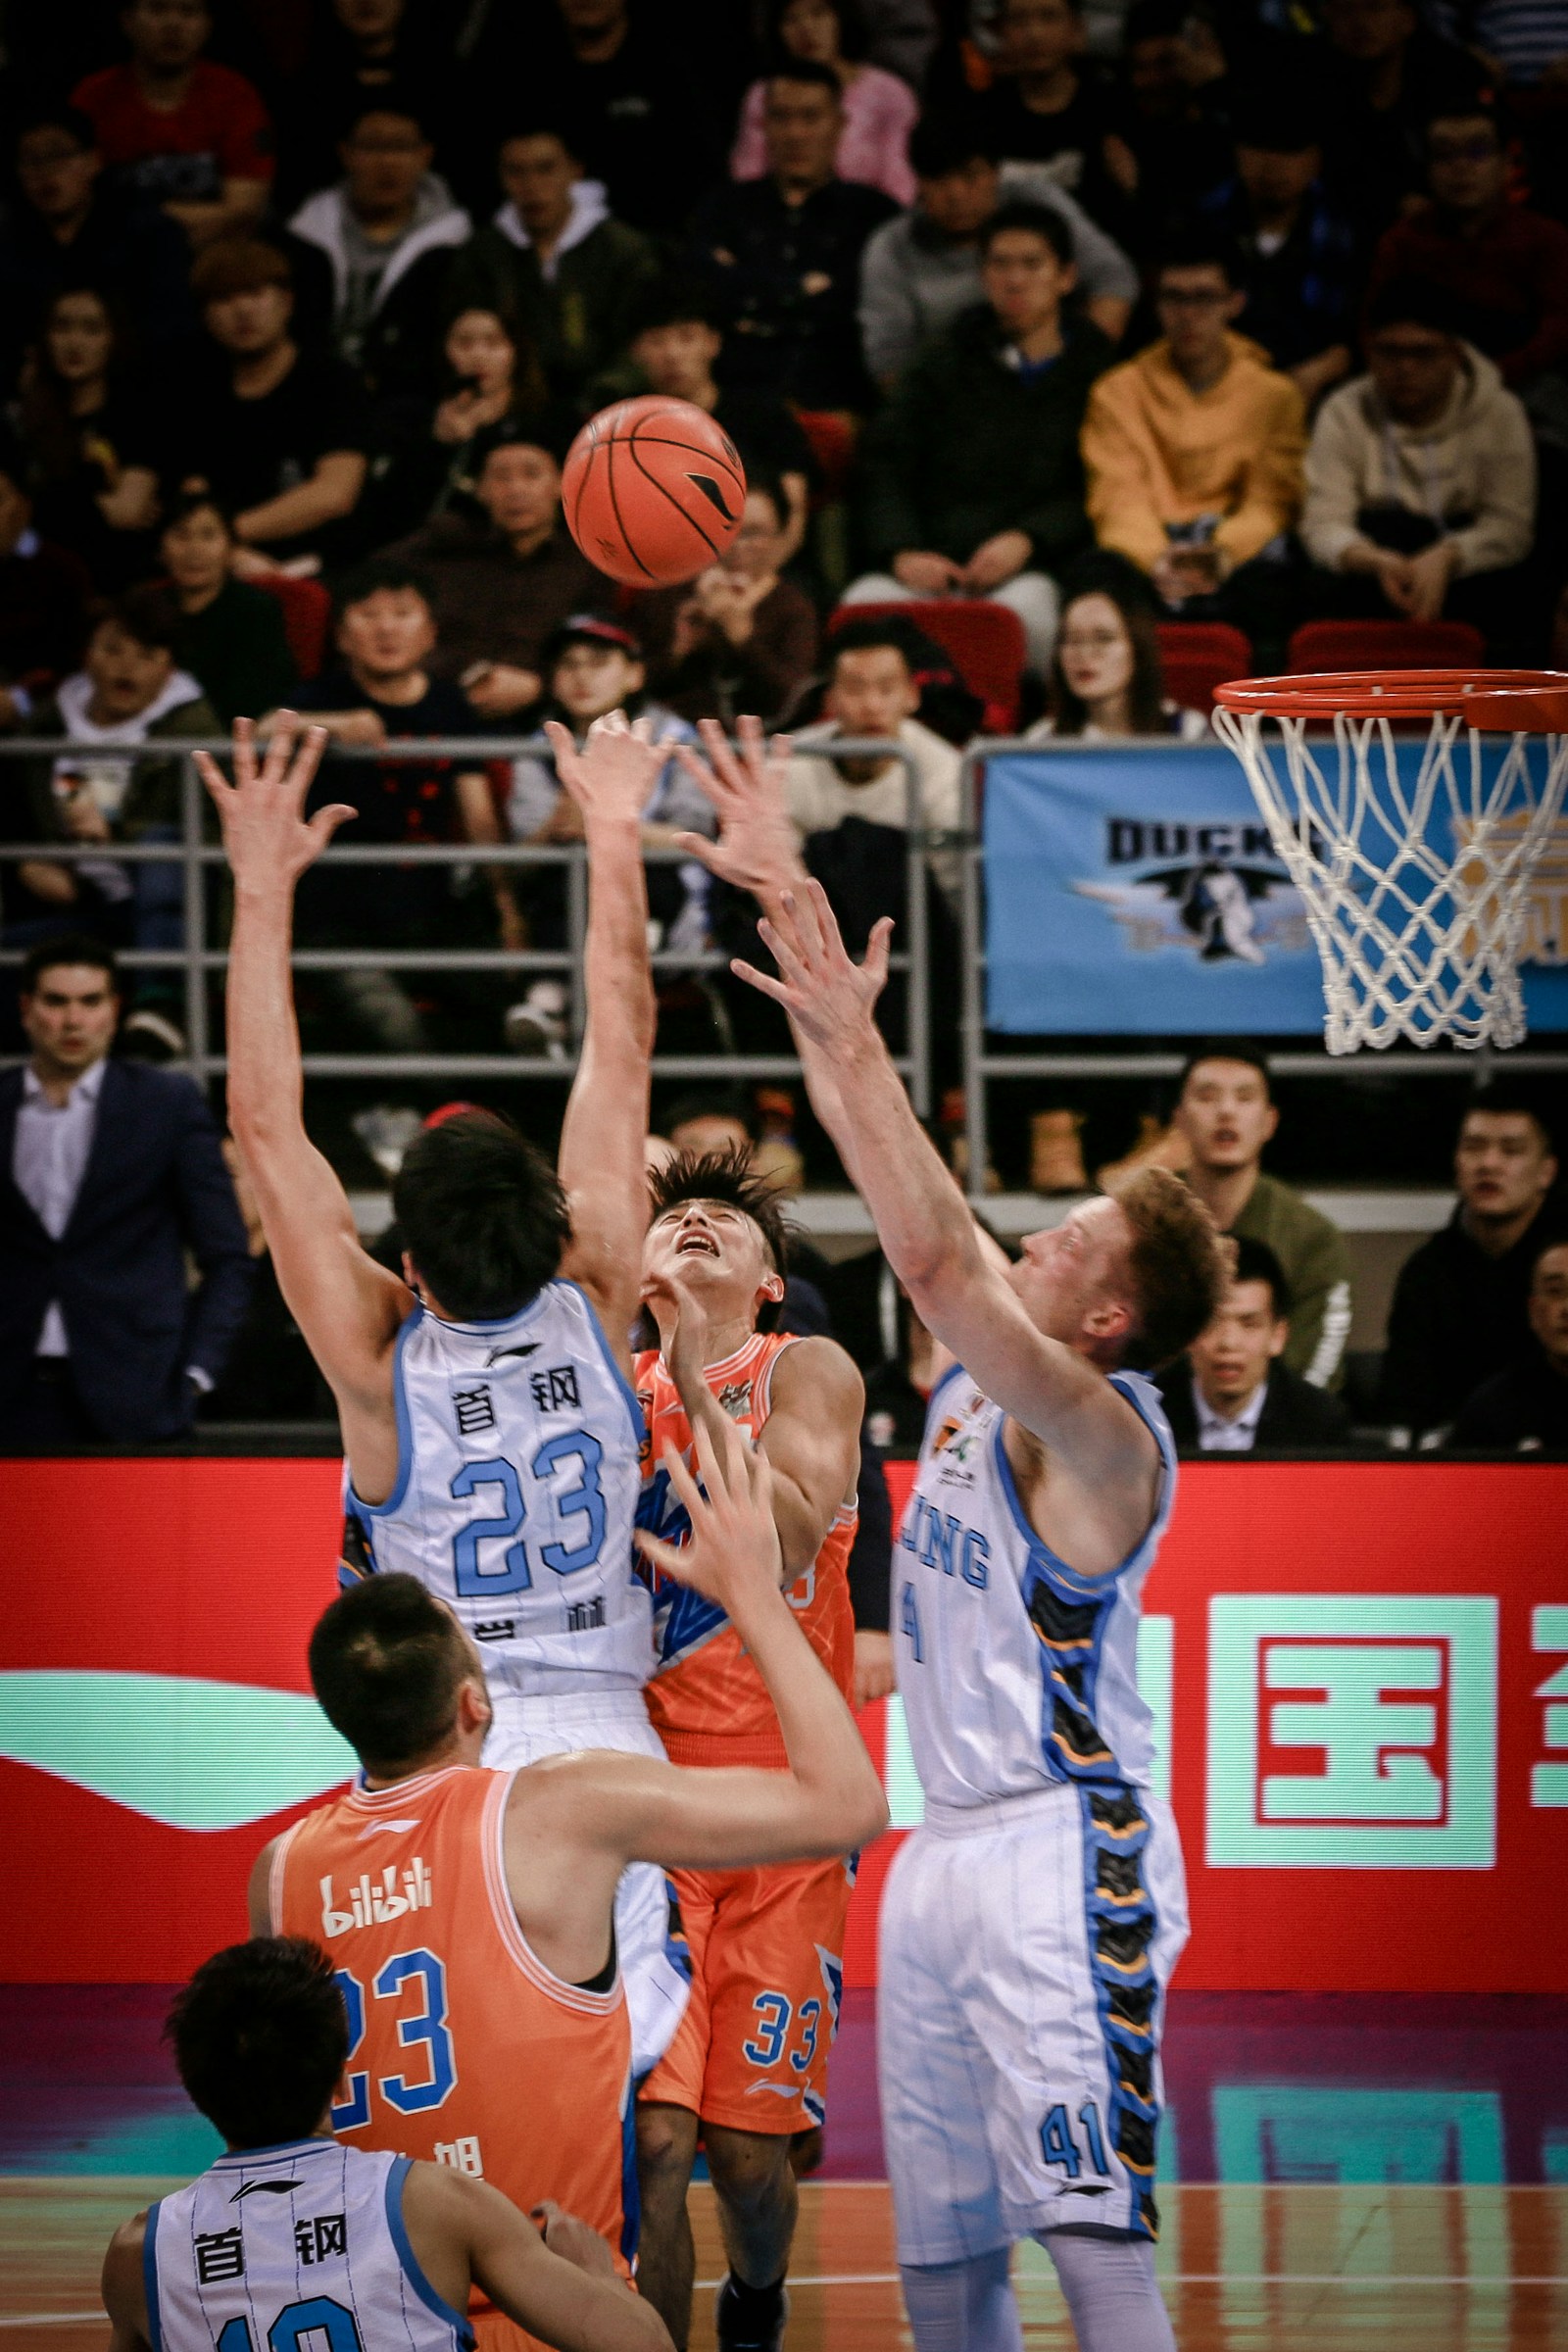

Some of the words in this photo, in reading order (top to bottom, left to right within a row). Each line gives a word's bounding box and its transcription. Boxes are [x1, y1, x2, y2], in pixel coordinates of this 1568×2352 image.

[454, 1366, 581, 1435] 首钢
[451, 1430, 607, 1597] 23
[319, 1857, 432, 1938] bilibili
[742, 1990, 822, 2073] 33
[1039, 2101, 1110, 2180] 41
[194, 2212, 349, 2286] 首钢
